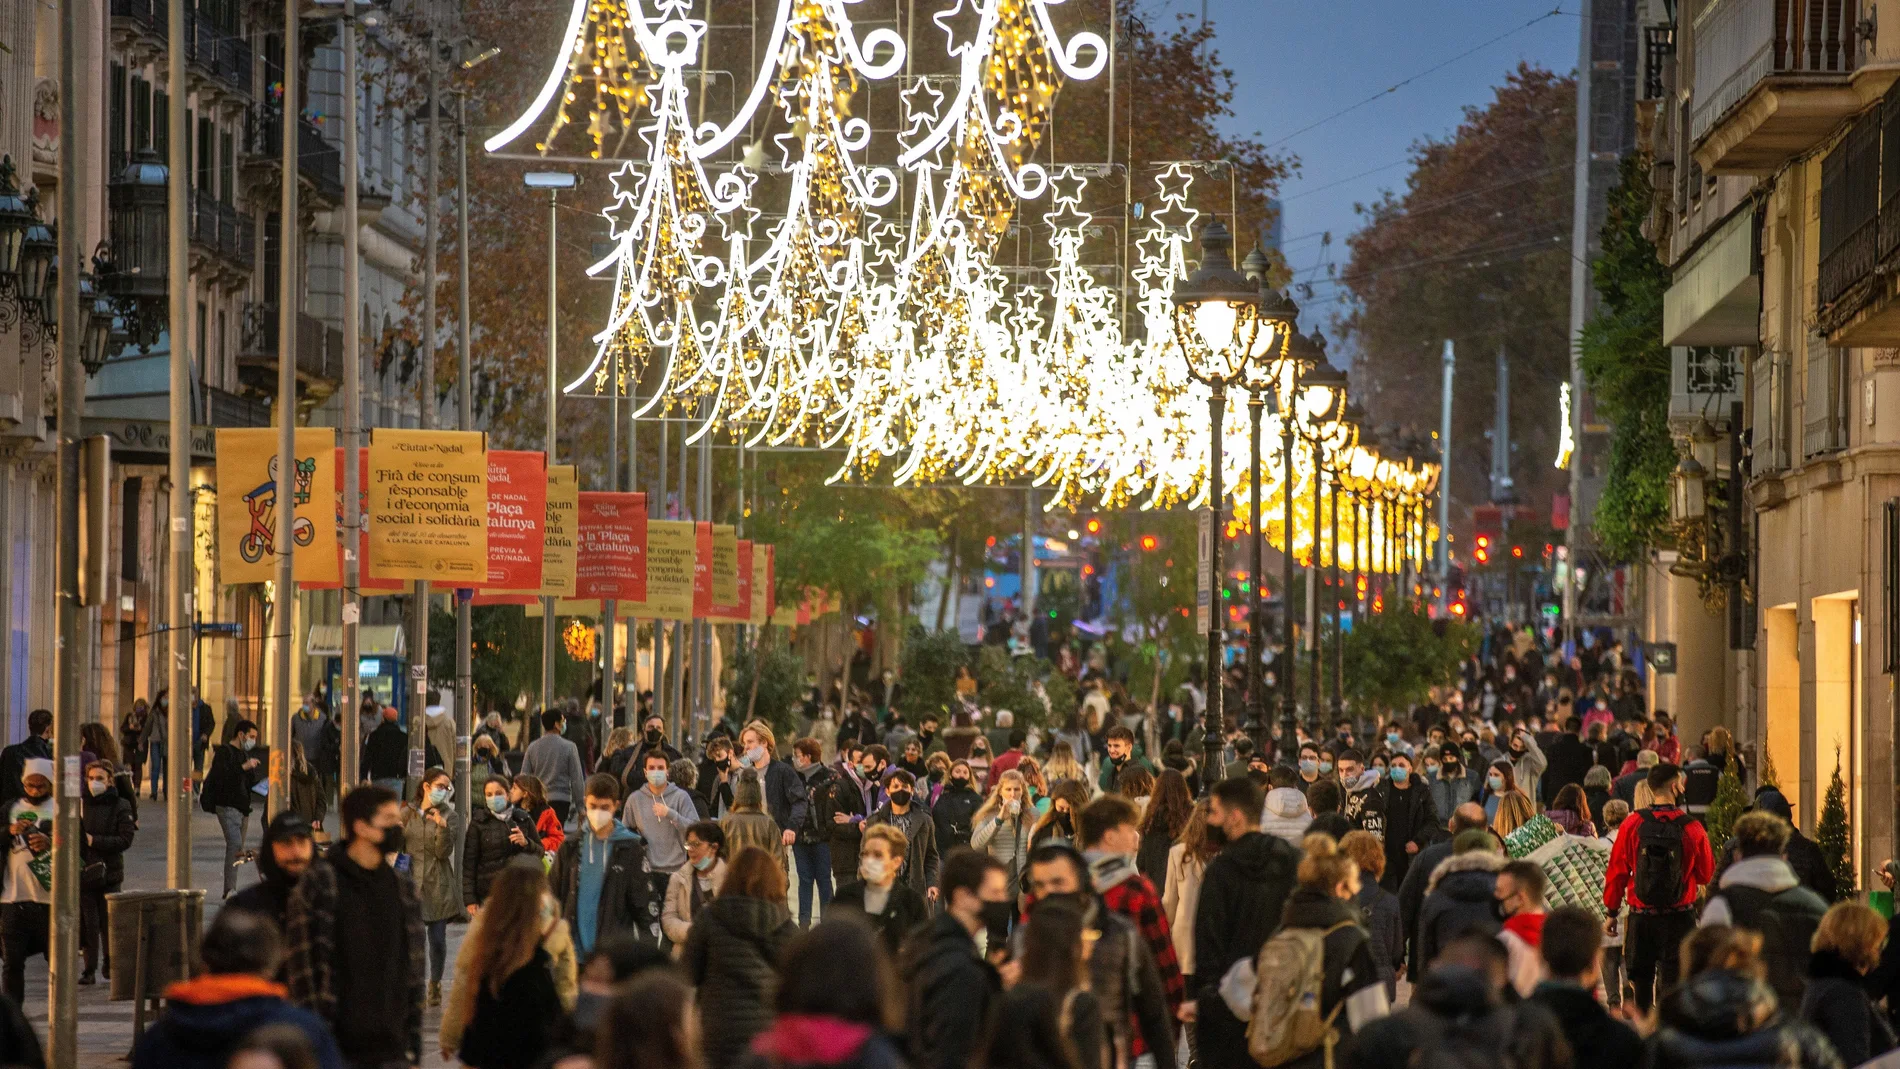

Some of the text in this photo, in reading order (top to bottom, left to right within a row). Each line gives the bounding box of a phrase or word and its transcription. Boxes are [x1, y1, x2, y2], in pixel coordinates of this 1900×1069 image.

[398, 442, 427, 452] Ciutat
[433, 443, 464, 454] Nadal
[487, 466, 507, 474] iutat
[407, 470, 424, 481] de
[428, 472, 480, 485] consum
[387, 499, 391, 510] i
[487, 501, 523, 518] Plaça
[376, 513, 480, 527] social i solidària
[487, 516, 536, 531] talunya
[545, 536, 572, 547] dària
[586, 531, 596, 540] la
[597, 530, 630, 544] Plaça
[490, 546, 517, 554] PRÈVIA
[577, 544, 584, 552] e
[585, 542, 640, 555] Catalunya
[657, 547, 691, 556] consum
